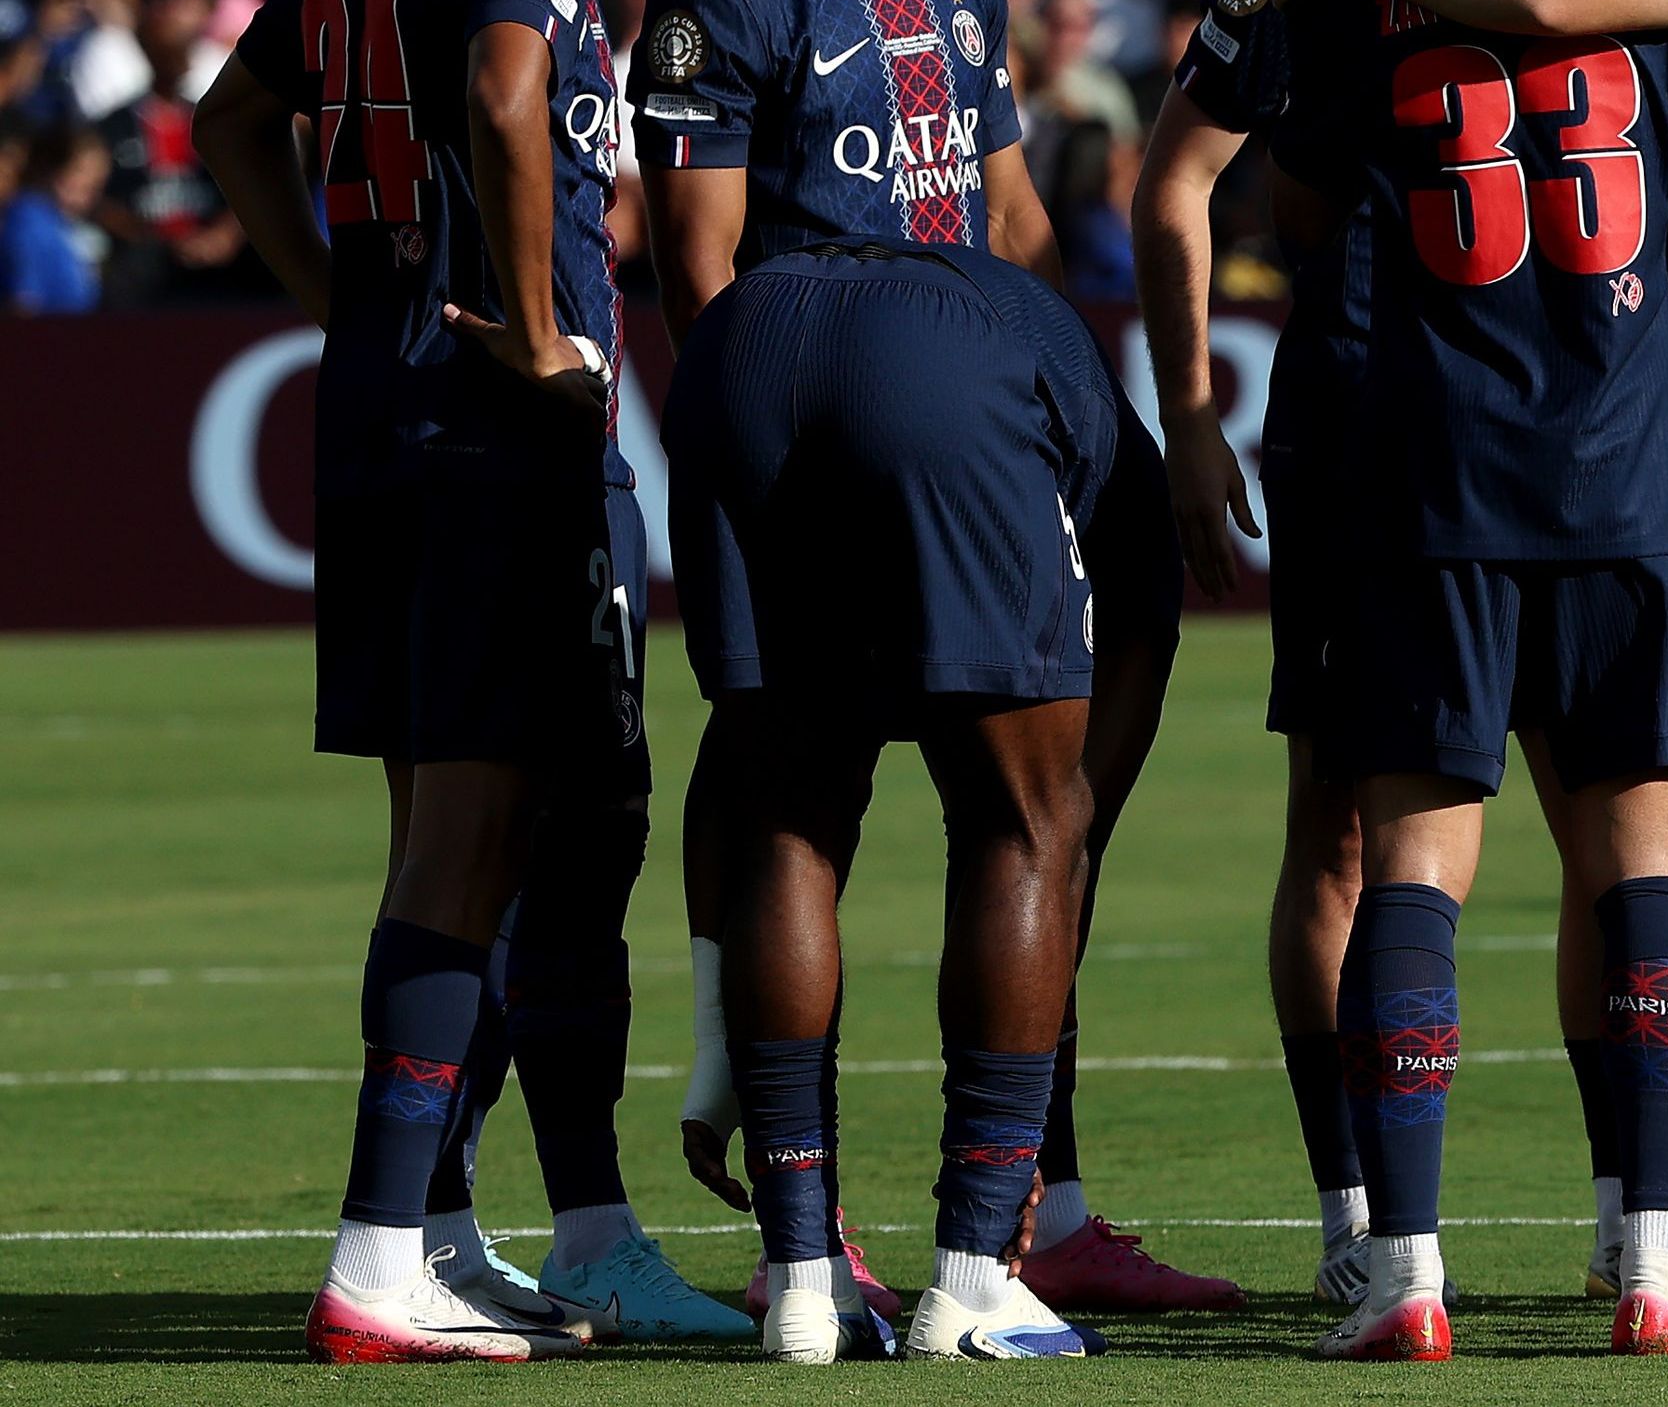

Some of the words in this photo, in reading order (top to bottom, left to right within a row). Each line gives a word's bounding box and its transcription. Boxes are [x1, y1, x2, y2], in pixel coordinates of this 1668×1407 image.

[681, 17, 699, 33] CUP
[660, 66, 687, 78] FIFA
[833, 107, 979, 183] QATAR
[1393, 35, 1647, 286] 33
[1396, 1055, 1459, 1072] PARIS
[325, 1324, 391, 1344] MERCURIAL
